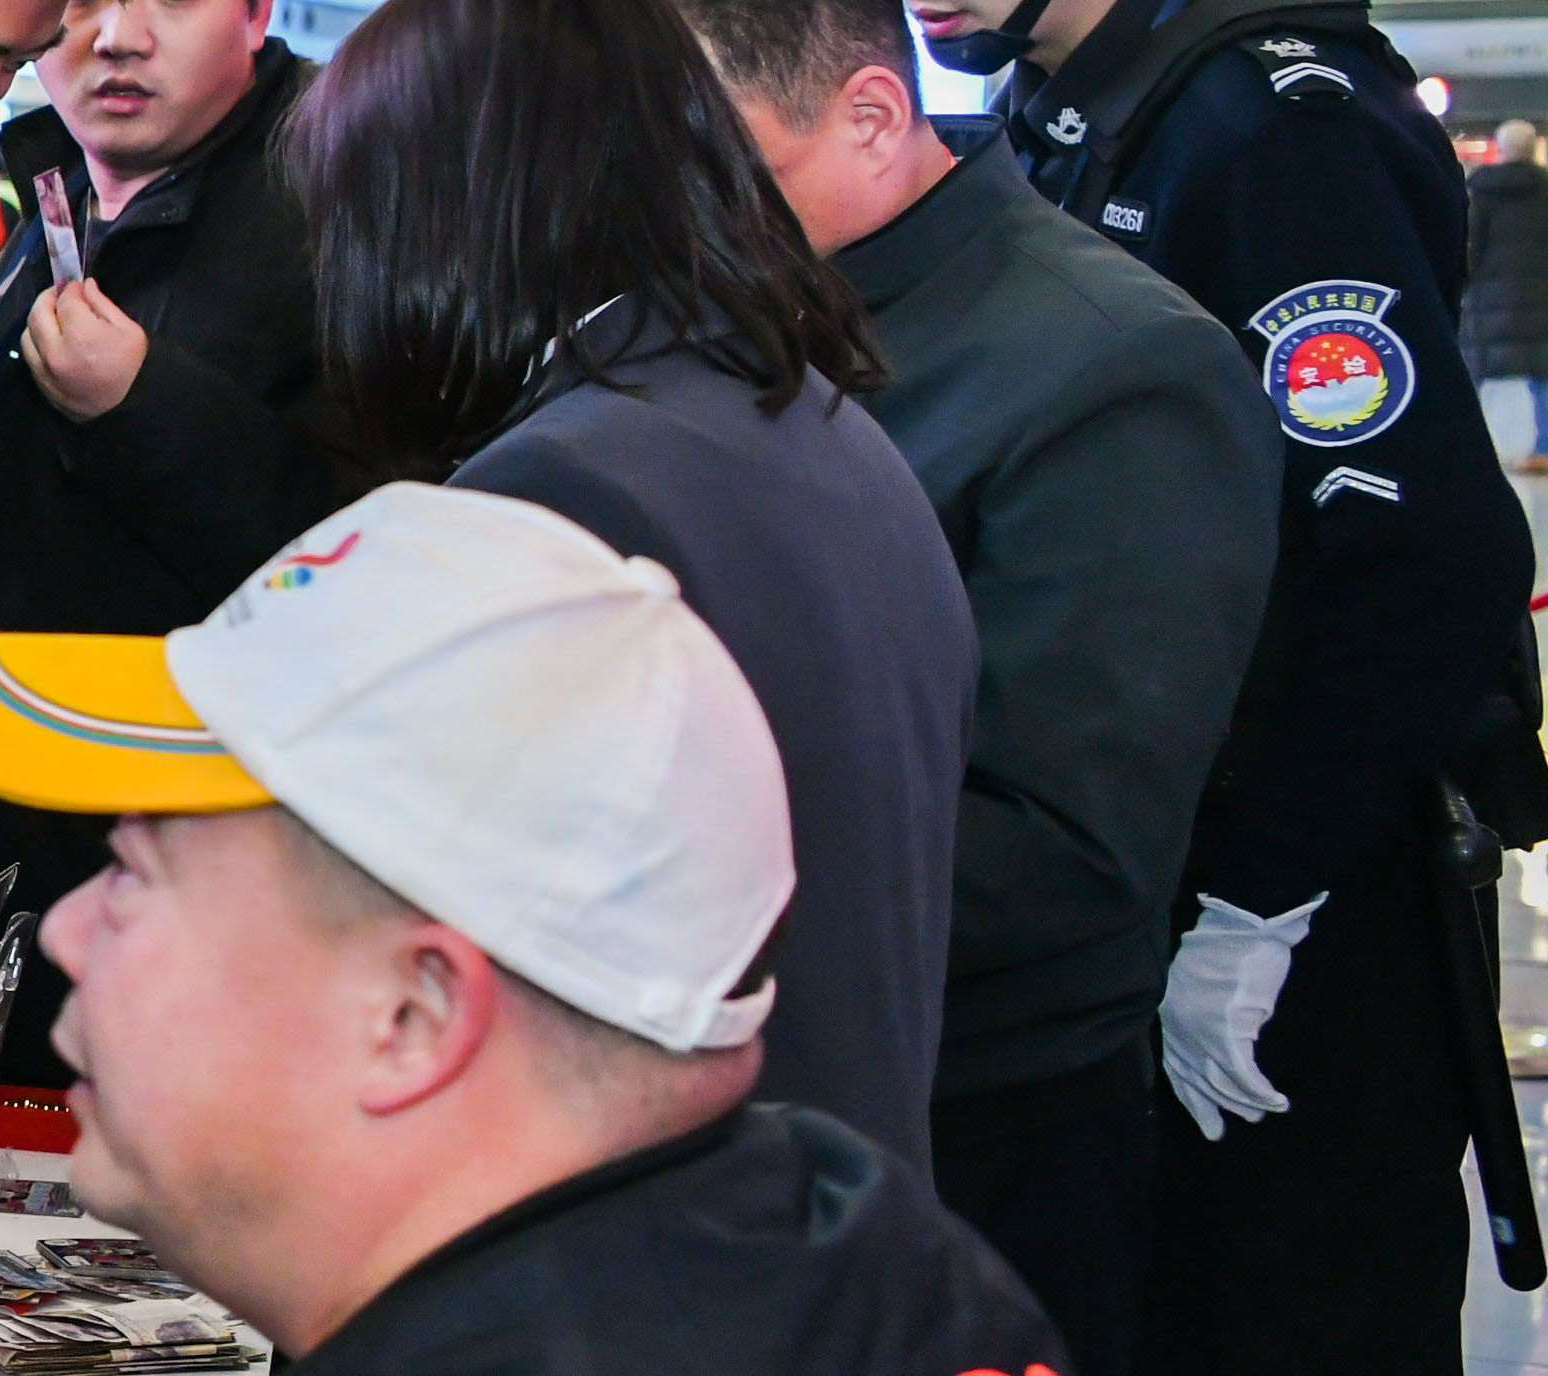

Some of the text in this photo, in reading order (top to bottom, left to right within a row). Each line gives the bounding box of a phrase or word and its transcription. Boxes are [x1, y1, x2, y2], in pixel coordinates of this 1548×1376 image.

[1265, 292, 1377, 333] 中华人民共和国
[1275, 321, 1394, 384] CHINA SECURITY
